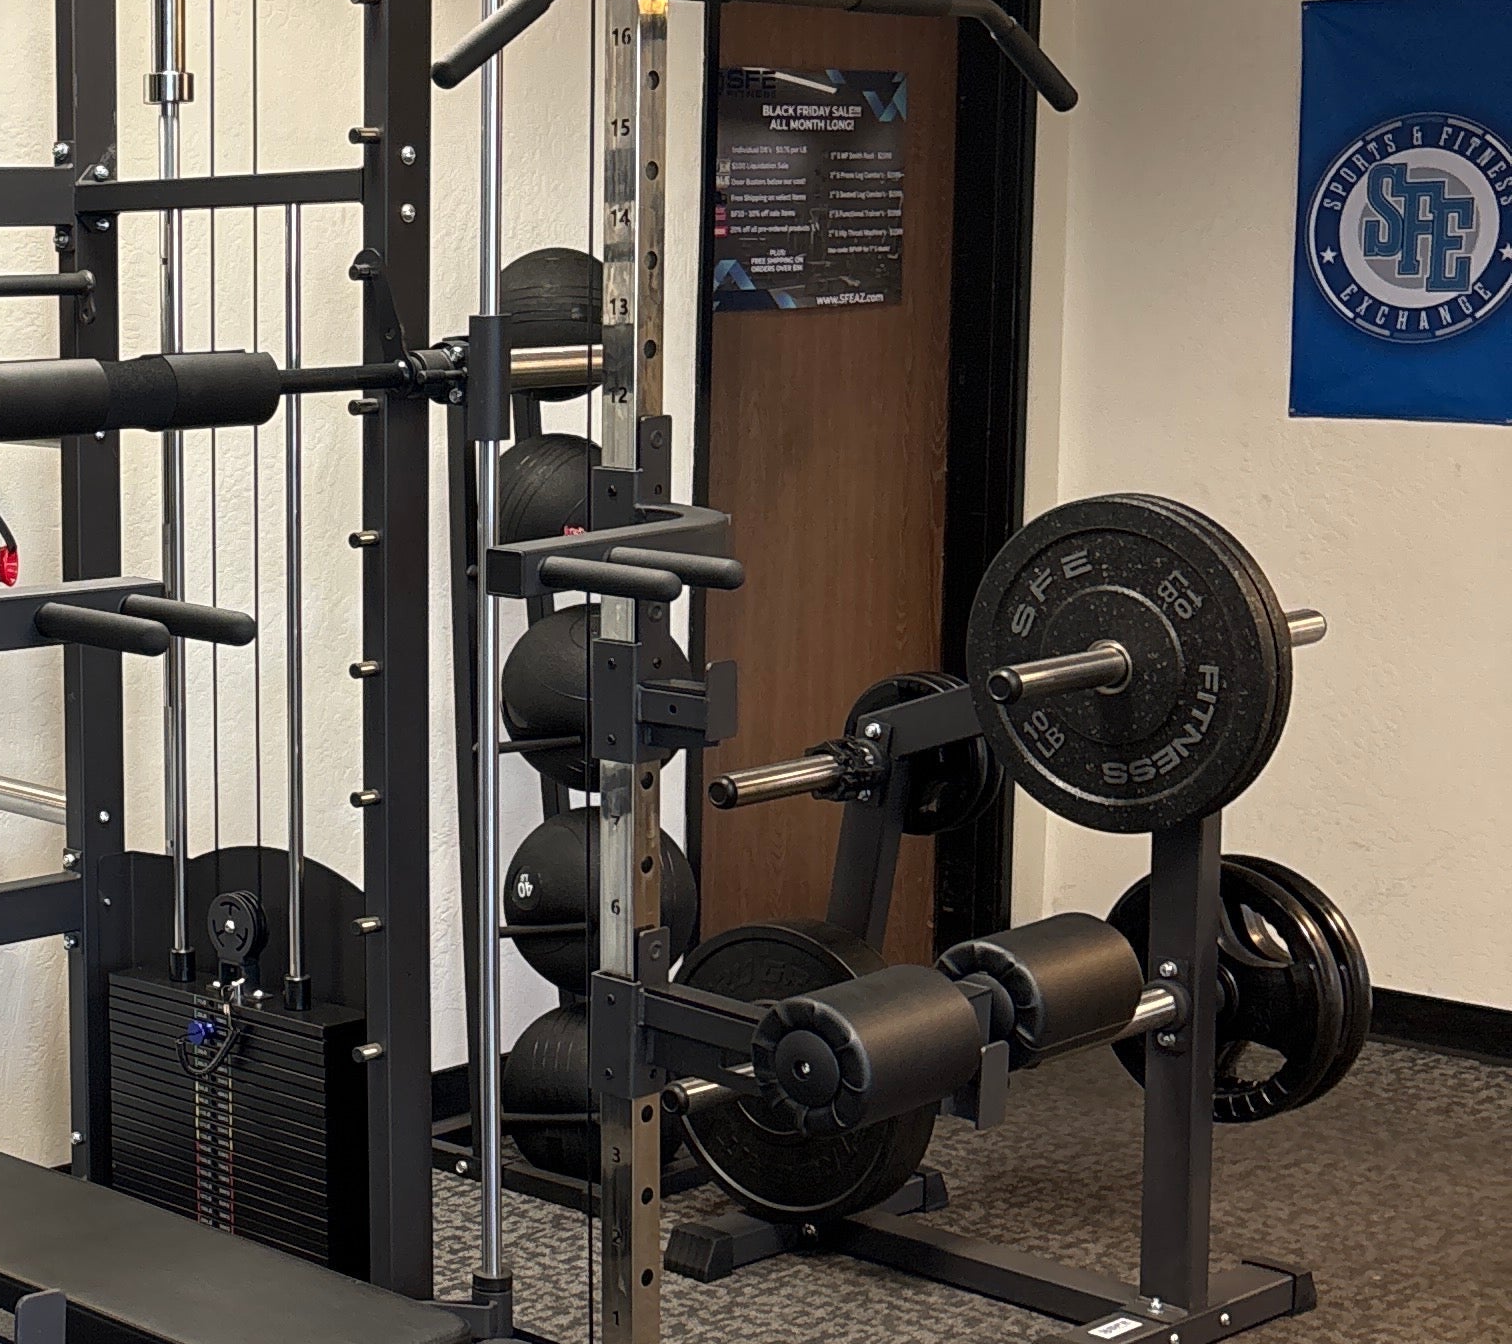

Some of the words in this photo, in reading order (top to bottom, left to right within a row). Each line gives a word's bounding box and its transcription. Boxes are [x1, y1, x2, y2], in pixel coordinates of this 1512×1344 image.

[611, 27, 632, 46] 16
[762, 105, 794, 117] BLACK
[796, 105, 830, 117] FRIDAY
[610, 118, 630, 136] 15
[769, 119, 787, 130] ALL
[790, 119, 825, 130] MONTH
[827, 119, 855, 131] LONG!
[1323, 133, 1398, 211] SPORTS
[1412, 125, 1422, 145] &
[1439, 125, 1512, 207] FITNESS
[609, 209, 630, 227] 14
[1363, 162, 1475, 293] SFE
[608, 297, 628, 316] 13
[816, 292, 884, 305] www.SFEAZ.com
[1340, 281, 1492, 331] EXCHANGE
[608, 387, 628, 404] 12
[1011, 549, 1093, 638] SFE
[1023, 710, 1050, 742] 10
[1101, 664, 1220, 786] FITNESS
[1037, 727, 1066, 758] LB
[610, 814, 621, 830] 7
[517, 882, 534, 898] 40
[611, 898, 621, 915] 6
[612, 1146, 621, 1163] 3
[612, 1228, 622, 1244] 2
[612, 1310, 620, 1326] 1
